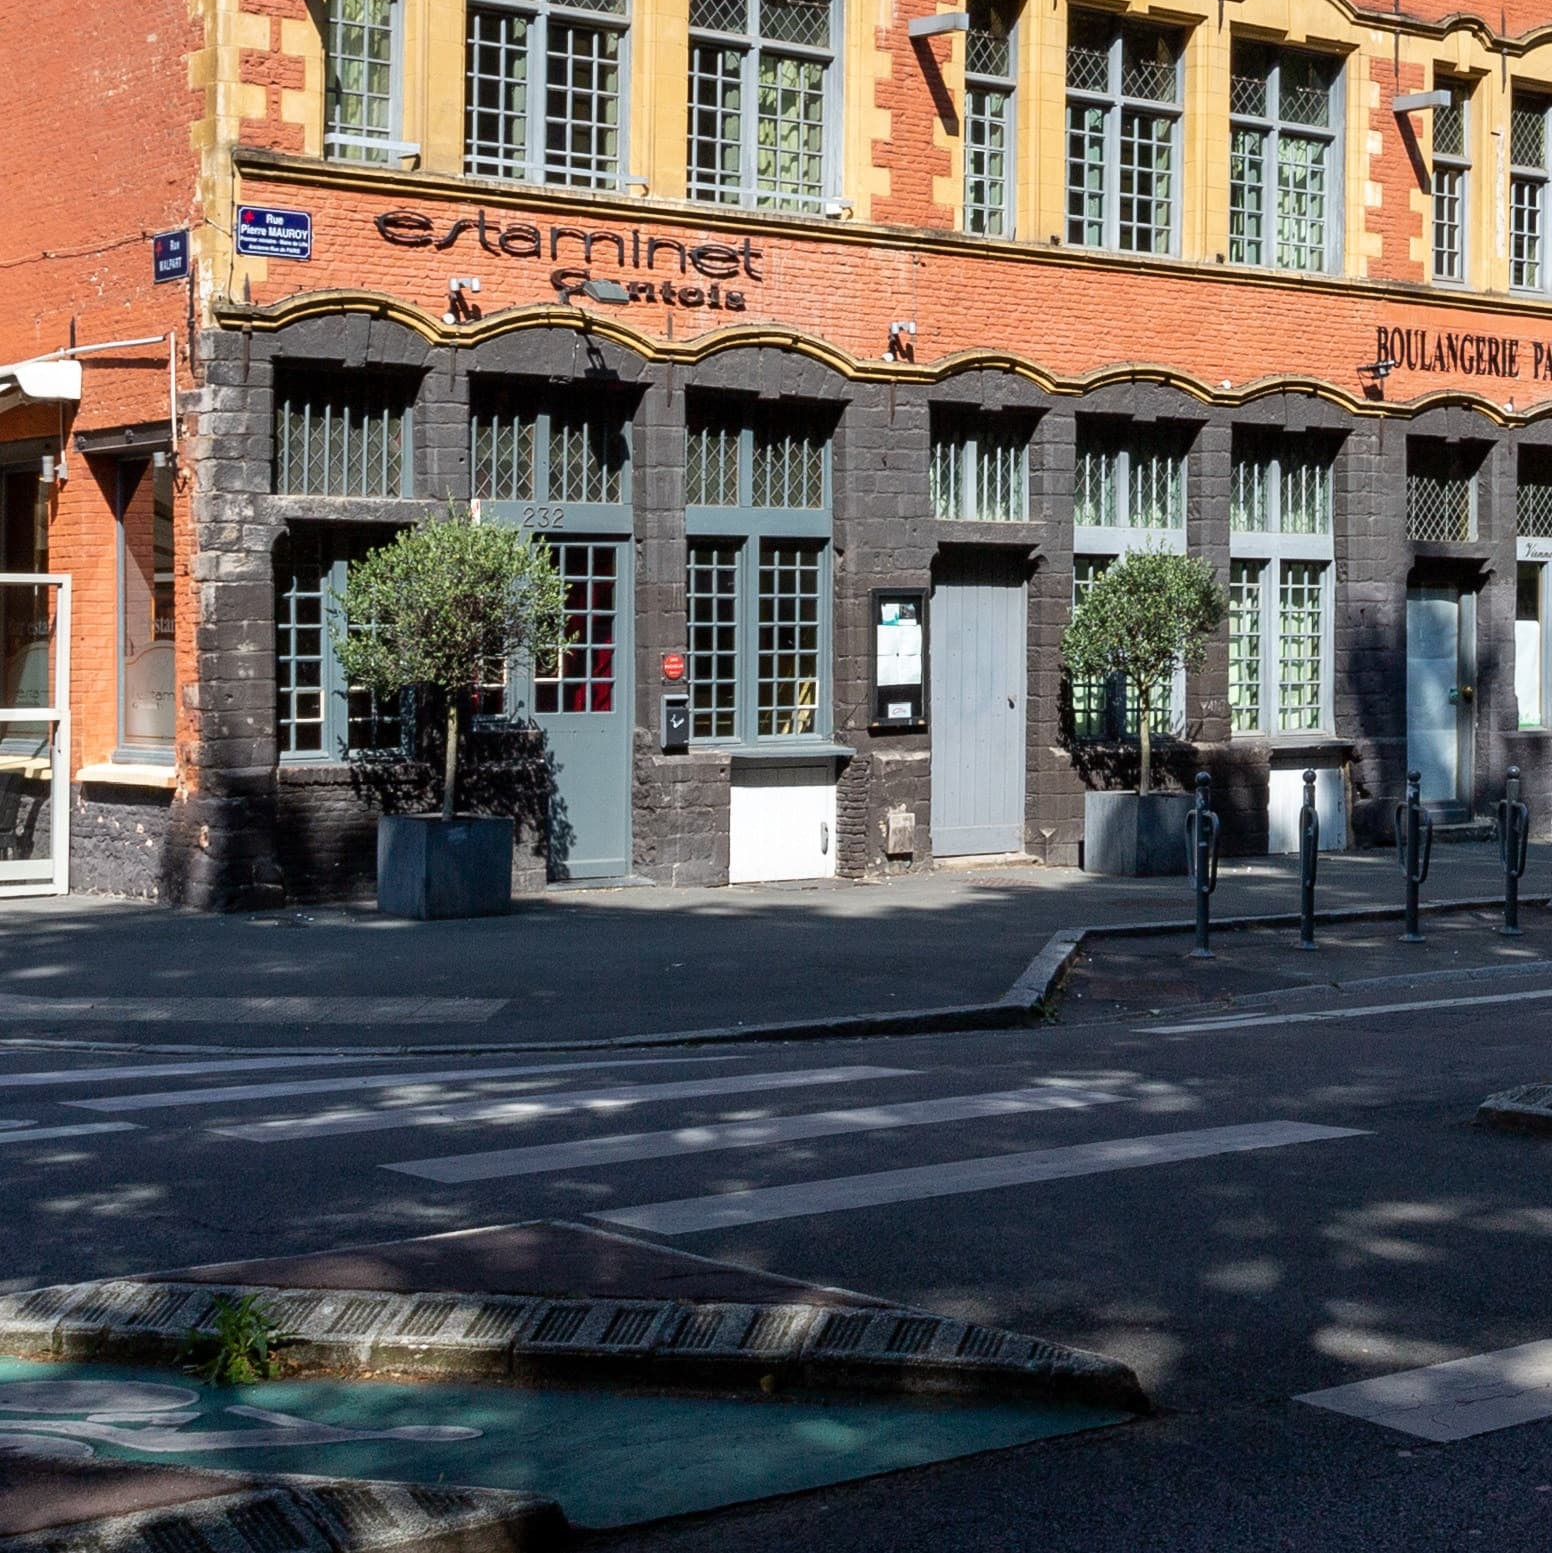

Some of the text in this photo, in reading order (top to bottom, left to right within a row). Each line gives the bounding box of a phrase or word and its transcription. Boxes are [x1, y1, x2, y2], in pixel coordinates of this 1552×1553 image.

[240, 224, 308, 239] Pierre MAUROY
[265, 213, 284, 225] Rue
[374, 209, 763, 281] estaminet
[550, 268, 747, 310] Gntois
[1376, 326, 1520, 379] BOULANGERIE
[522, 506, 565, 529] 232
